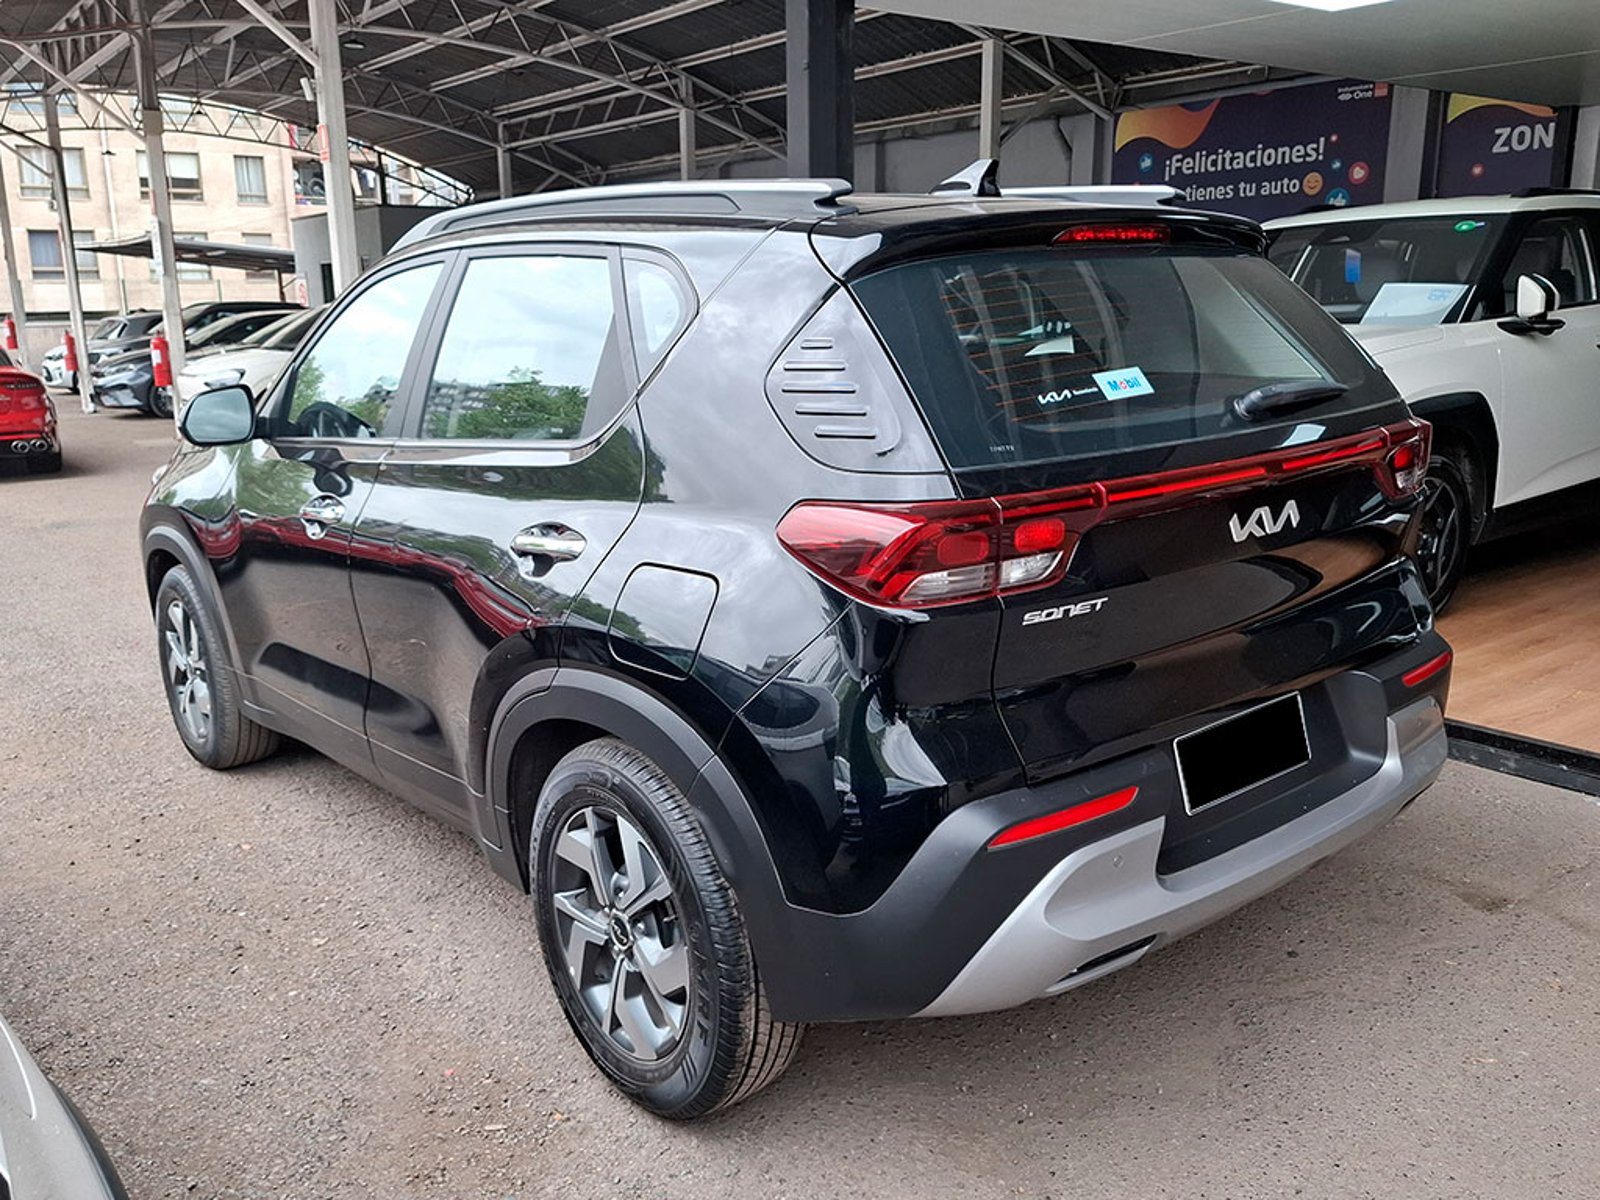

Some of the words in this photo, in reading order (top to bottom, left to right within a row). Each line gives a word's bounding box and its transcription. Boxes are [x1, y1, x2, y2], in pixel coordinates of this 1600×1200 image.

[1491, 122, 1556, 154] ZON
[1164, 136, 1325, 181] ¡Felicitaciones!
[1185, 183, 1234, 202] tienes
[1238, 181, 1256, 197] tu
[1260, 176, 1300, 196] auto
[1107, 376, 1141, 392] Mobil
[1228, 499, 1300, 543] KIA
[1022, 597, 1109, 626] SONET
